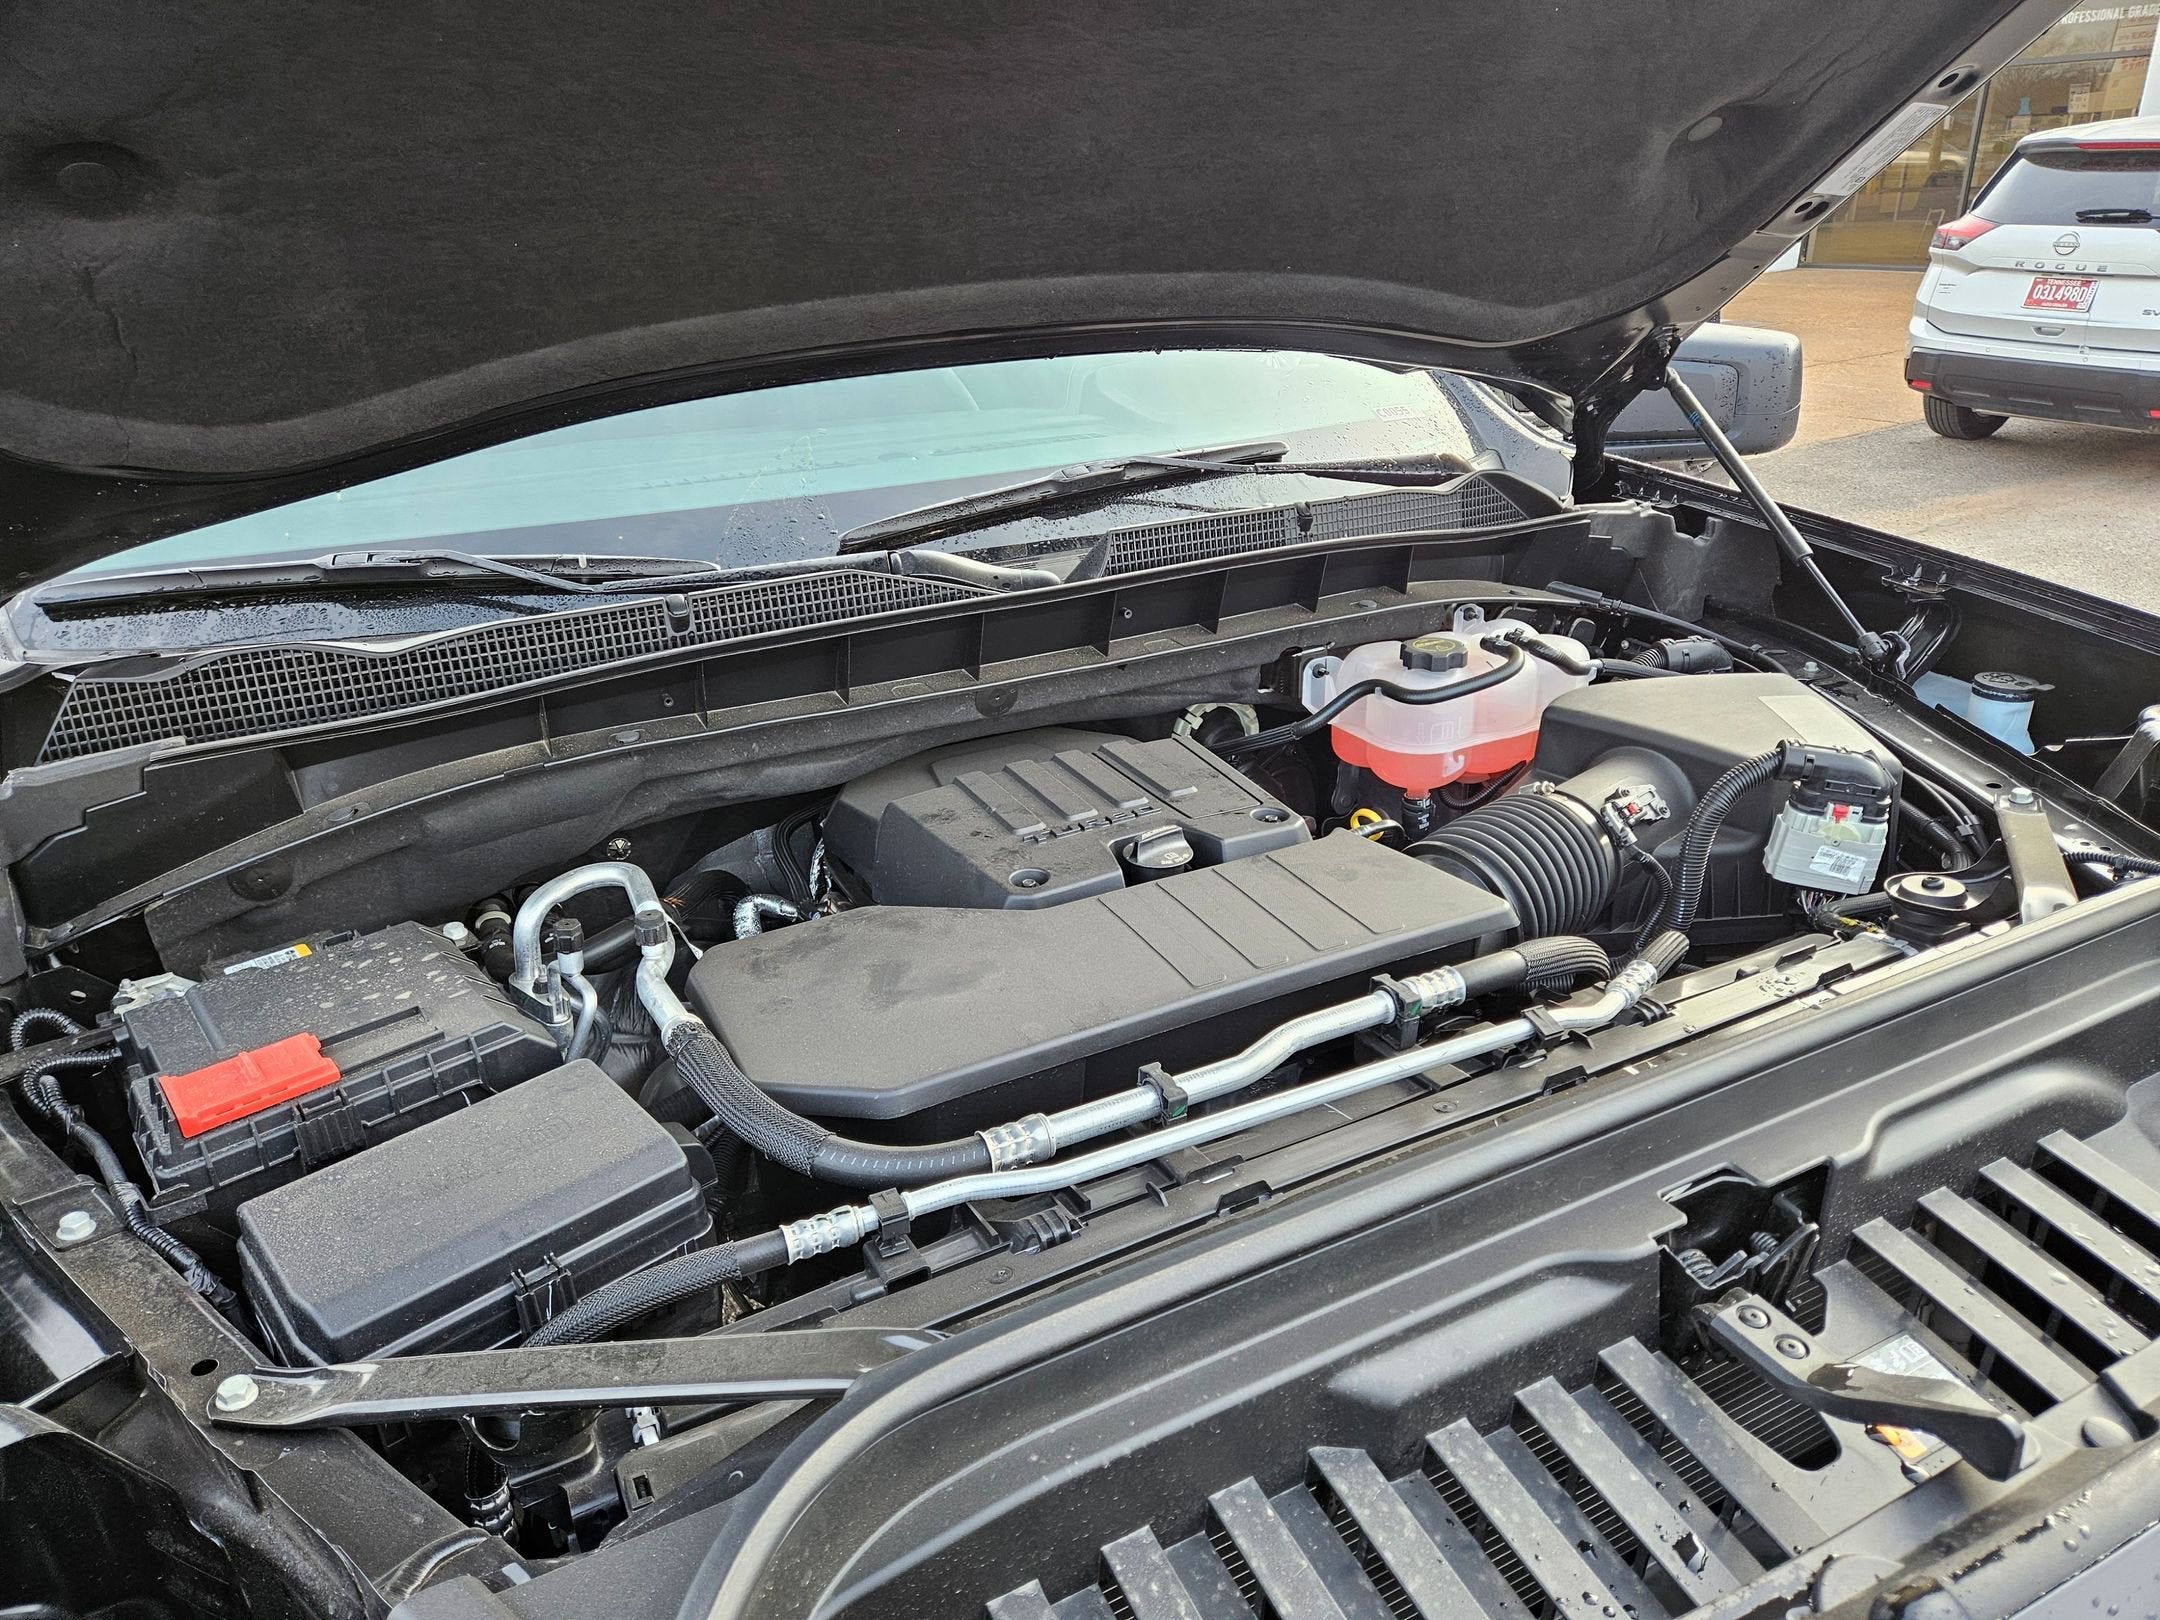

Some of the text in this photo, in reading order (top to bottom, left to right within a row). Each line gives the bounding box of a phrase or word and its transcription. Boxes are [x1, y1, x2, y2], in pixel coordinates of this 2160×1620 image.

[2056, 7, 2125, 25] ROFESSIONAL
[2015, 261, 2108, 272] ROGUE
[2047, 279, 2081, 287] TENNESSEE
[2032, 284, 2089, 302] 031498D
